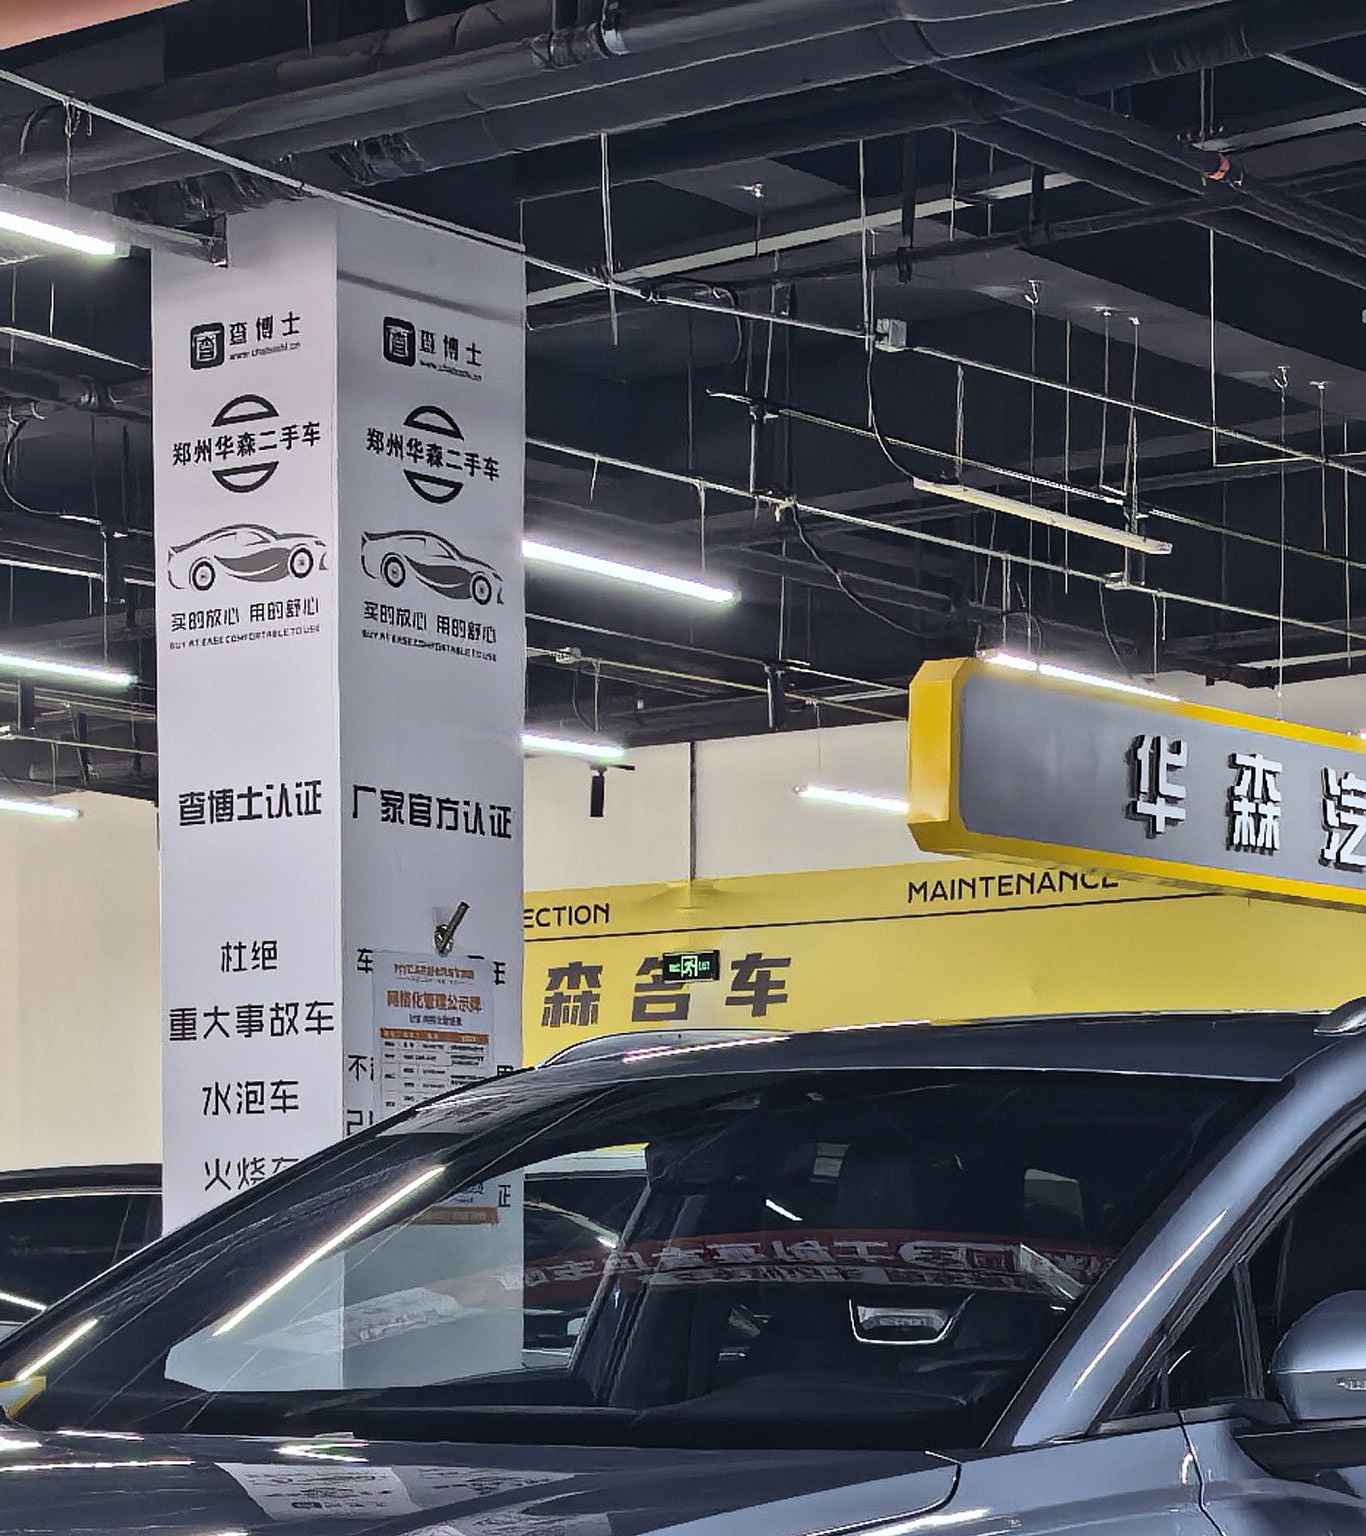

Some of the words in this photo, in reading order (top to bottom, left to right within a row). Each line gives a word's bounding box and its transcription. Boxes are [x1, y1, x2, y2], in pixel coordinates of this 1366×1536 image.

[172, 421, 322, 467] 郑州华森二手车
[366, 427, 501, 482] 郑州华森二手车
[171, 606, 240, 632] 买的放心
[249, 595, 320, 623] 用的舒心
[363, 600, 428, 632] 买的放心
[436, 614, 498, 644] 用的舒心
[178, 779, 323, 827] 查博士认证
[351, 783, 513, 839] 厂家官方认证
[220, 939, 279, 974] 杜绝
[168, 1000, 335, 1042] 重大事故车
[201, 1078, 301, 1117] 水泡车
